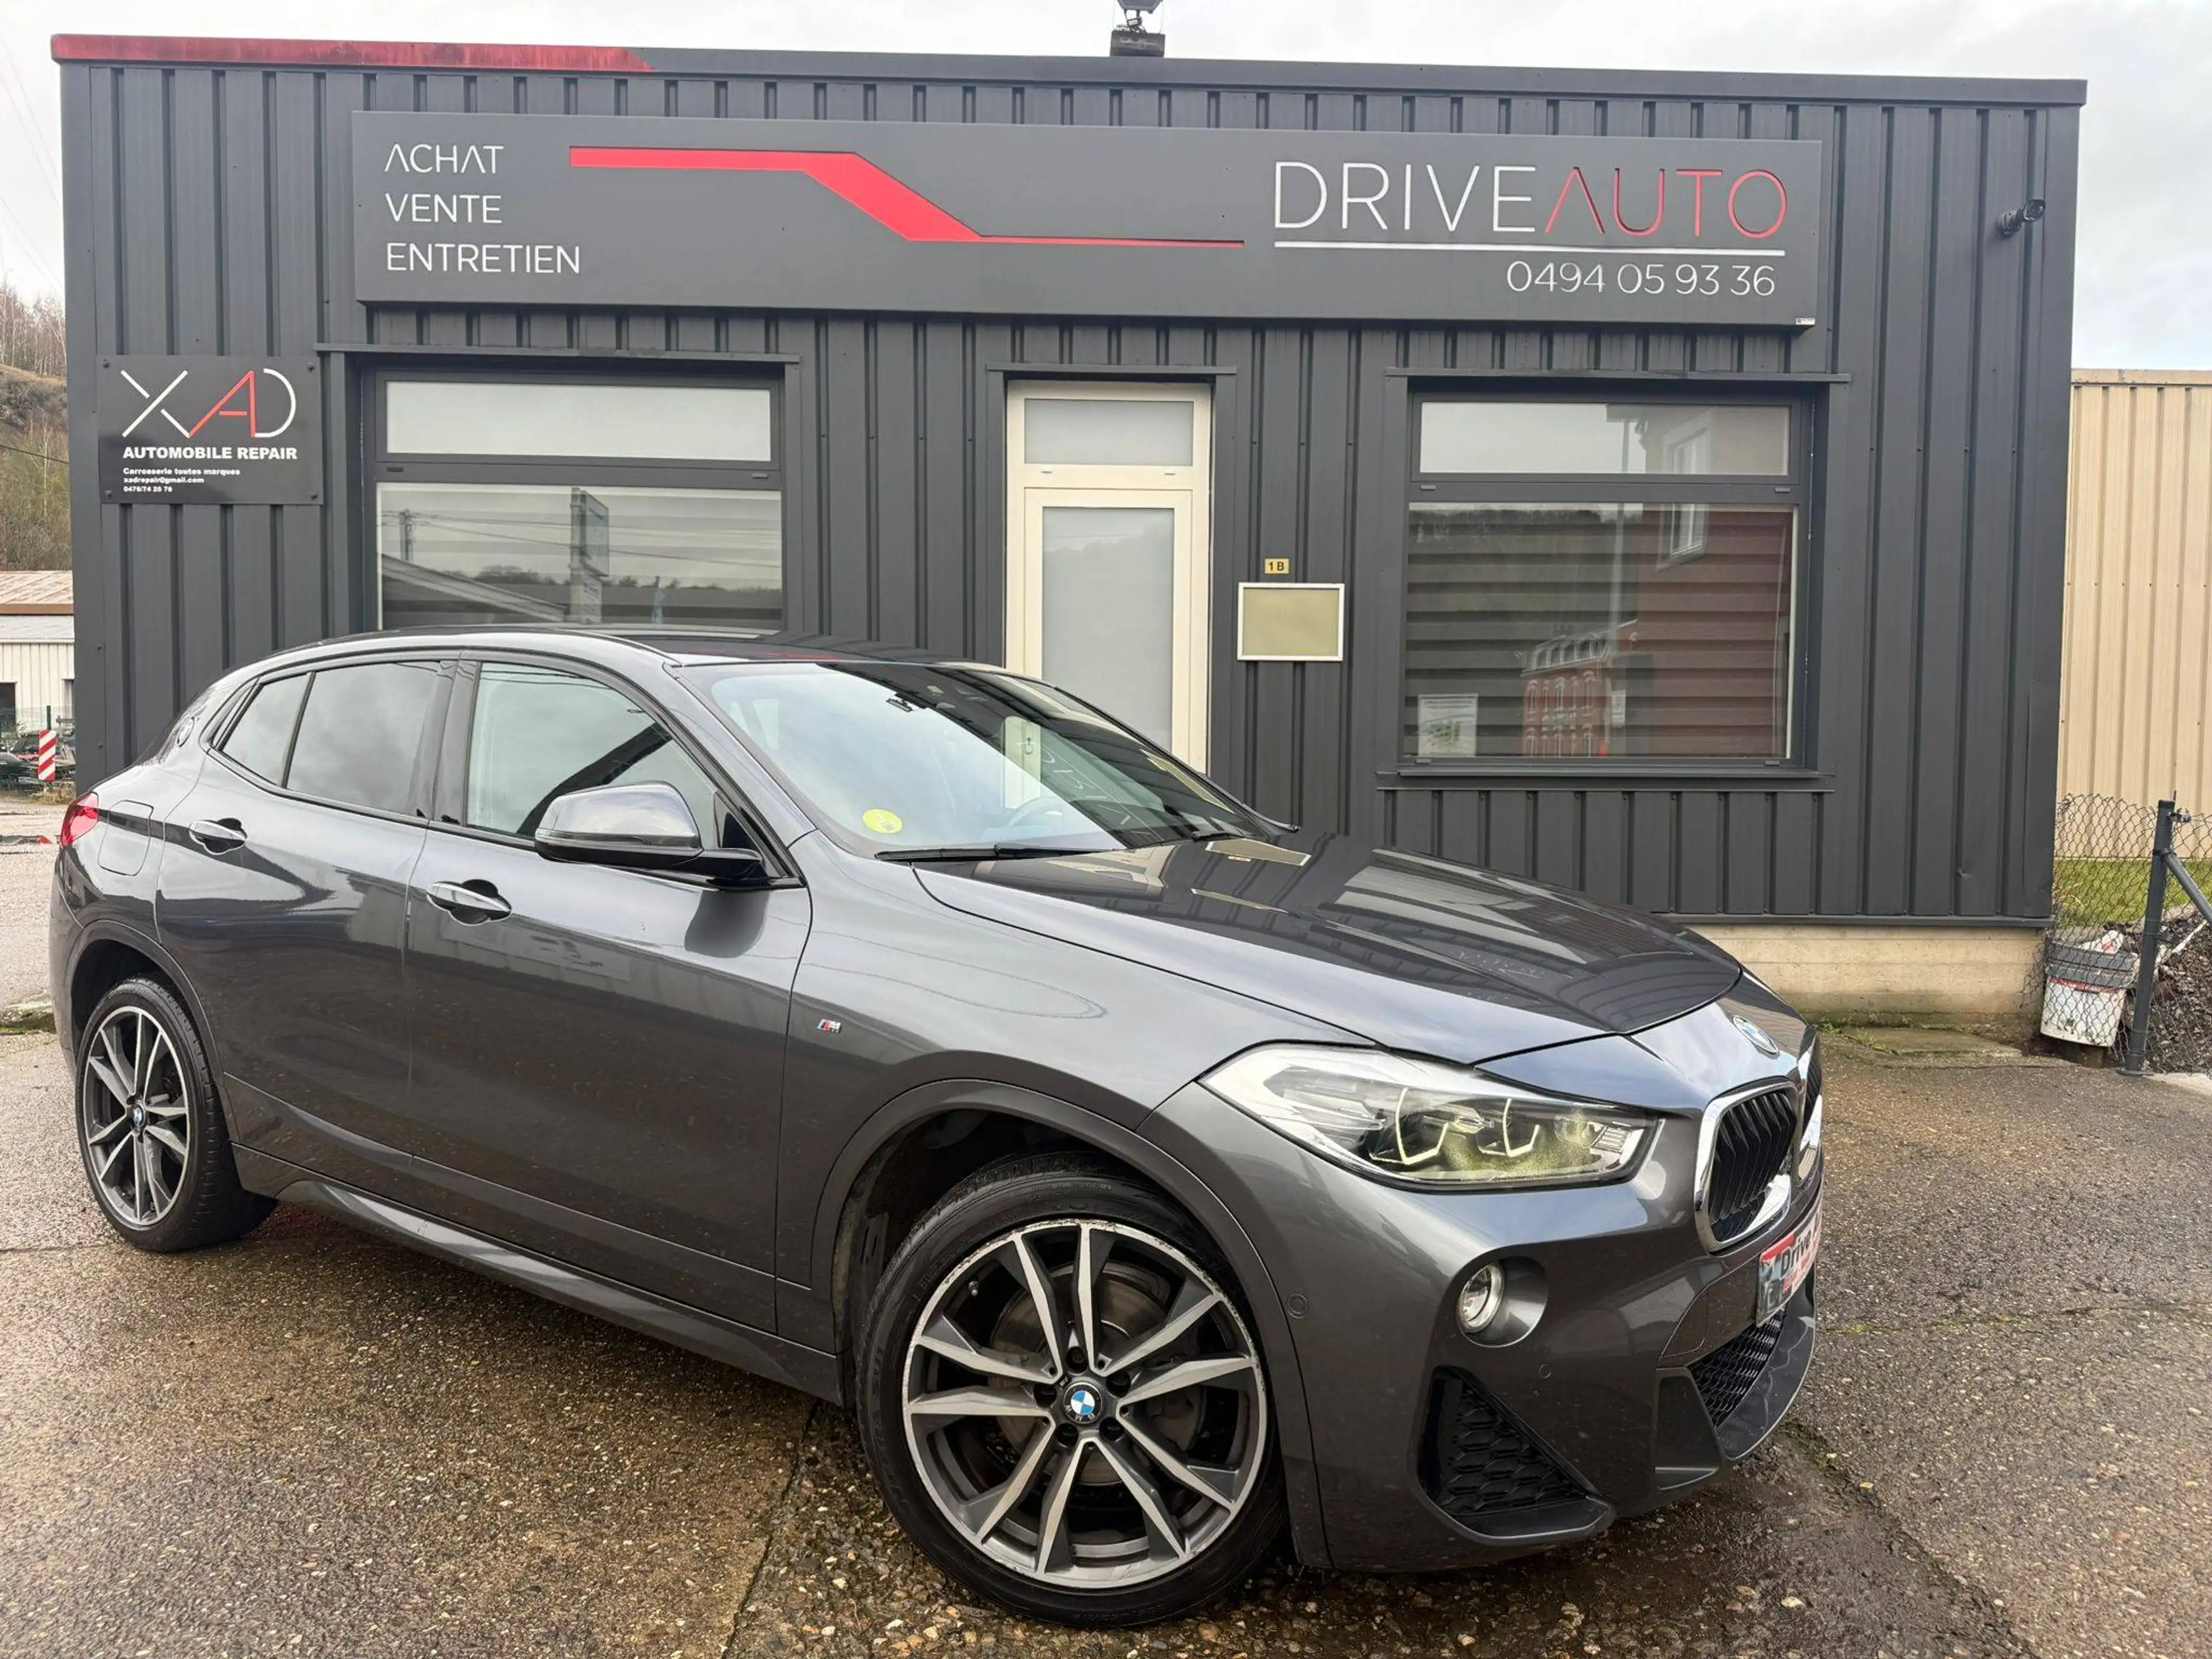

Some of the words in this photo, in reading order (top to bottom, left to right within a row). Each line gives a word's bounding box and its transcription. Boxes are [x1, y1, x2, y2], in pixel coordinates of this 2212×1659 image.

[385, 143, 503, 174] ACHAT
[384, 192, 502, 224] VENTE
[387, 242, 580, 274] ENTRETIEN
[1506, 260, 1605, 293] 0494
[1617, 263, 1666, 294] 05
[1674, 264, 1720, 295] 93
[1729, 265, 1776, 296] 36
[120, 368, 296, 438] XAD
[123, 446, 233, 459] AUTOMOBILE
[237, 447, 298, 460] REPAIR
[123, 467, 173, 475] Carrosserie
